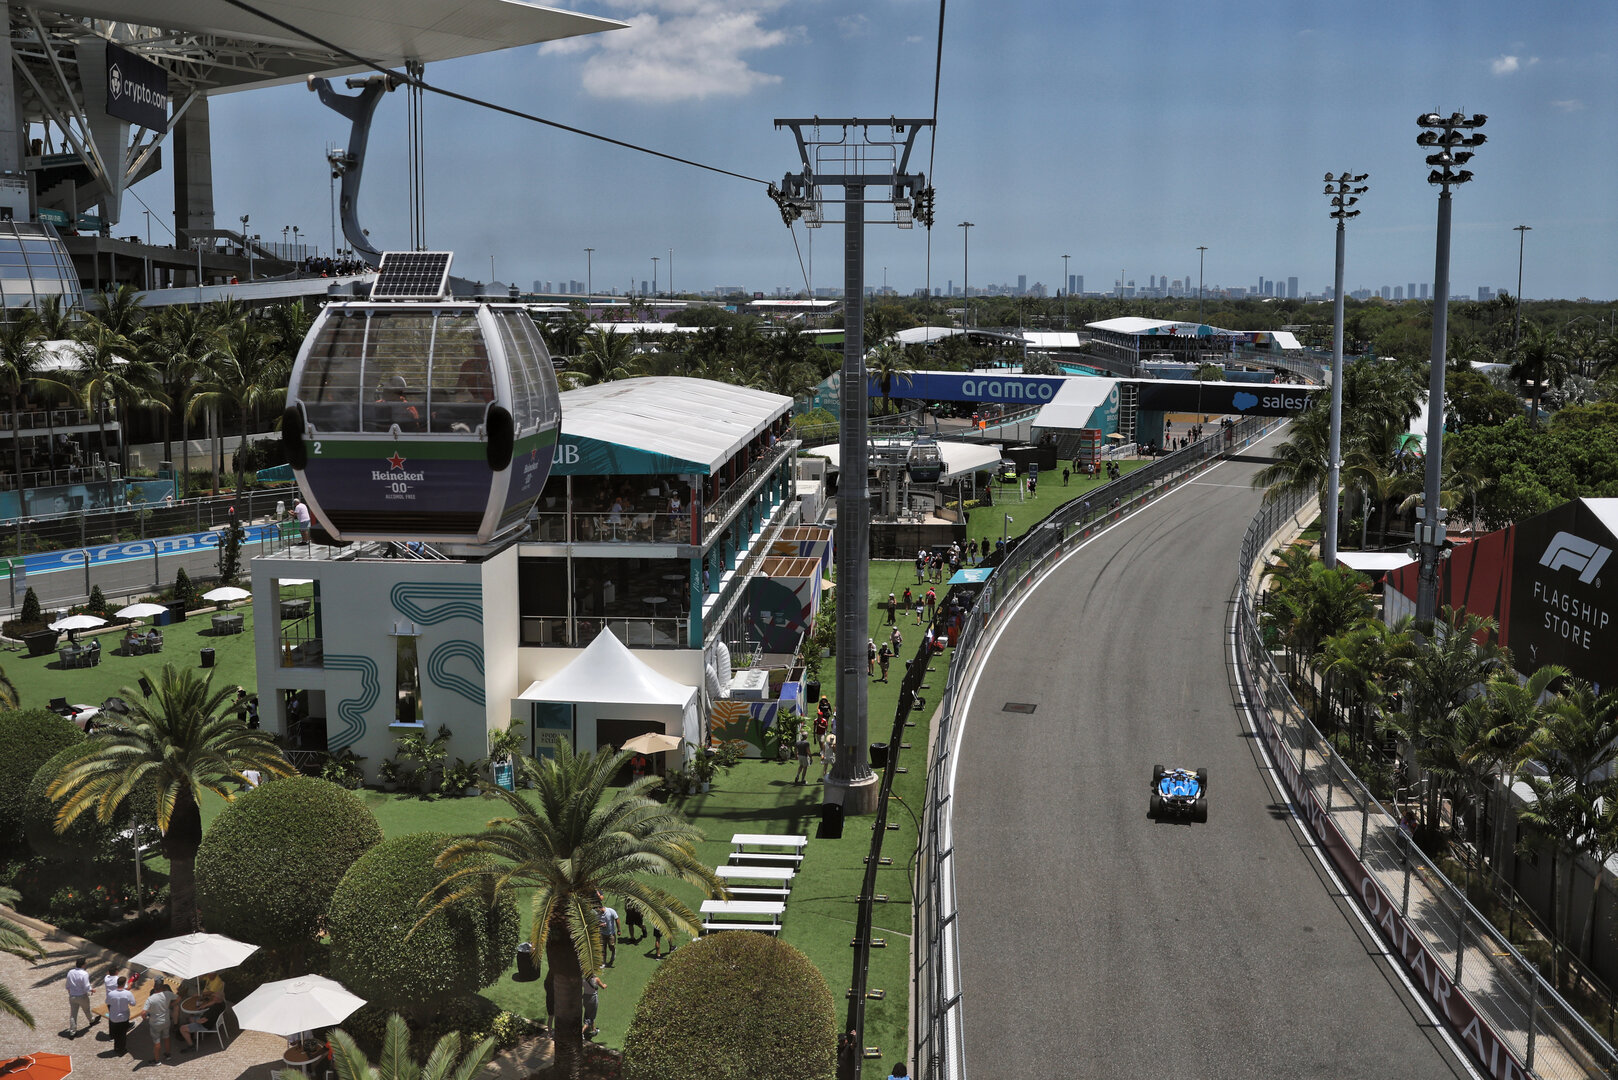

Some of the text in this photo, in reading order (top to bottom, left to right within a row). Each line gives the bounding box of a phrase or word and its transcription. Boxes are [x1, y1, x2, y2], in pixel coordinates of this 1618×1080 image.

[123, 79, 167, 110] crypto.com
[961, 379, 1053, 400] aramco
[1109, 385, 1120, 414] 9
[313, 441, 322, 454] 2
[371, 470, 424, 481] Heineken
[1533, 581, 1609, 630] FLAGSHIP
[1544, 611, 1591, 650] STORE
[1273, 741, 1328, 841] AIRWAYS
[1361, 876, 1452, 1021] QATAR
